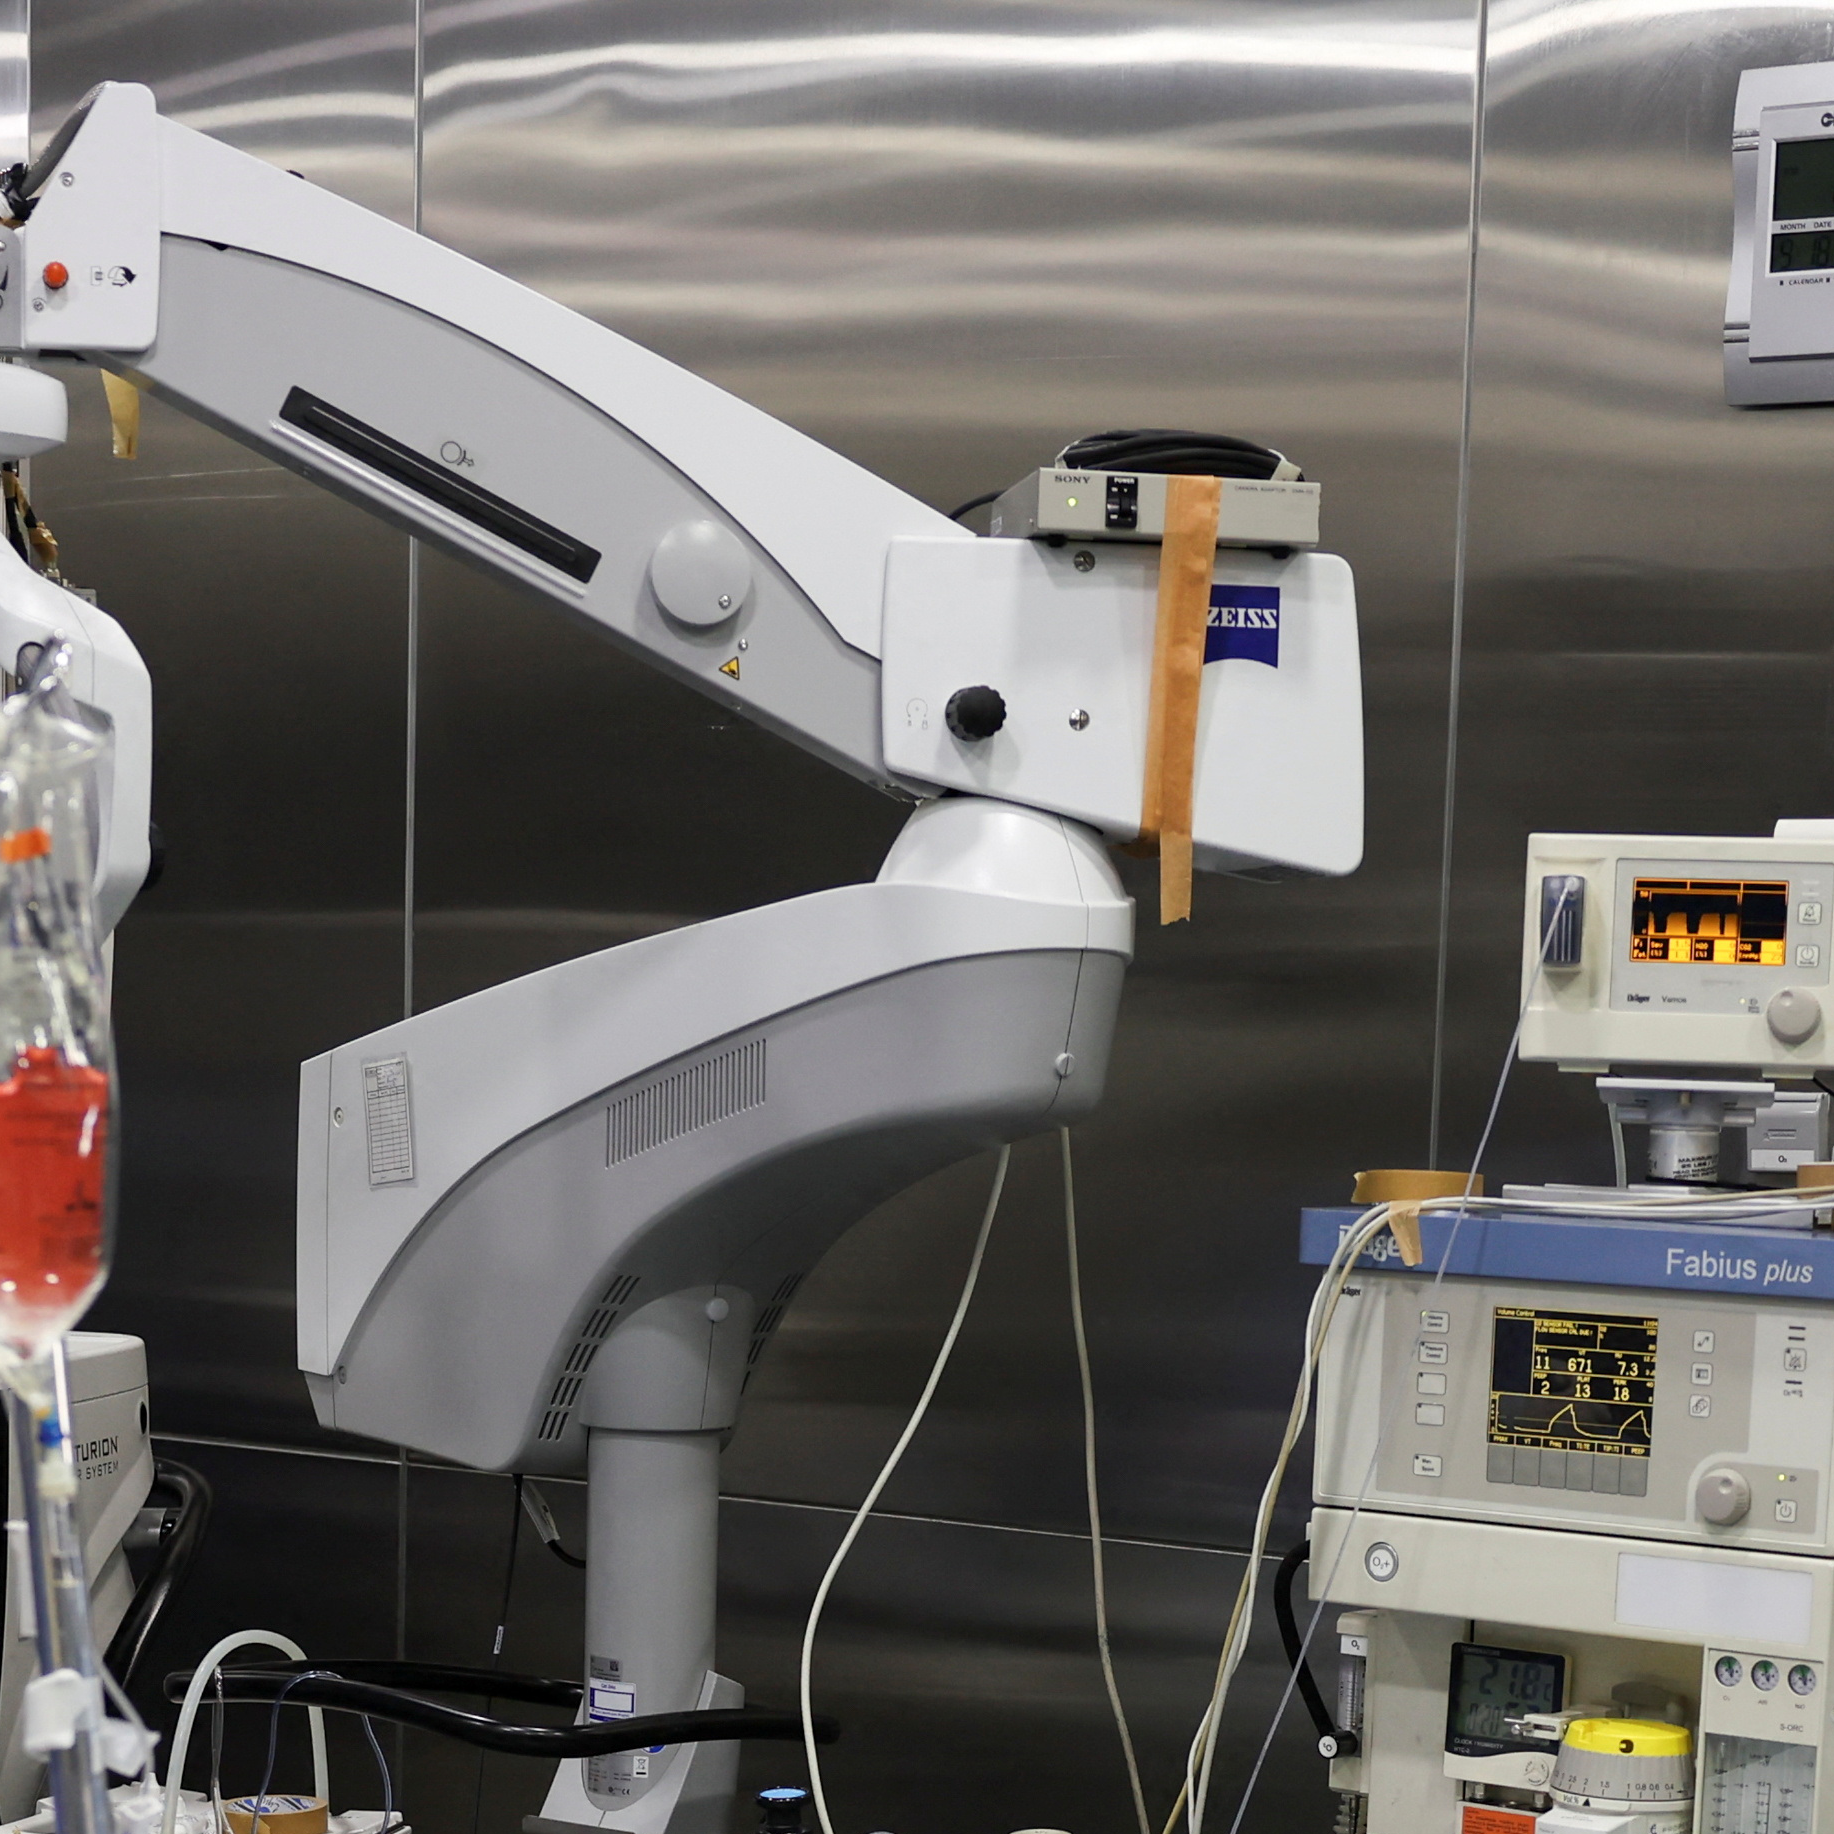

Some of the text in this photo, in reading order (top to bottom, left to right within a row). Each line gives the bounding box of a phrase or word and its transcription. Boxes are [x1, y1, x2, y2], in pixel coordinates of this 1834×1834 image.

[1780, 223, 1806, 231] MONTH
[1814, 221, 1832, 229] DATE
[1788, 277, 1824, 286] CALENDAR
[1054, 474, 1135, 485] SONY POWER
[1206, 607, 1277, 629] ZEISS
[1627, 993, 1650, 1003] Dräger
[1666, 1248, 1813, 1286] Fabius plus
[1341, 1286, 1361, 1296] räger
[1535, 1356, 1550, 1369] 11
[1568, 1358, 1592, 1373] 671
[1617, 1361, 1638, 1376] 7.3
[1540, 1381, 1550, 1395] 2
[1575, 1384, 1591, 1398] 13
[1613, 1387, 1630, 1401] 18
[75, 1435, 118, 1462] TURION
[86, 1461, 118, 1480] SYSTEM
[1780, 1724, 1804, 1732] S-ORC
